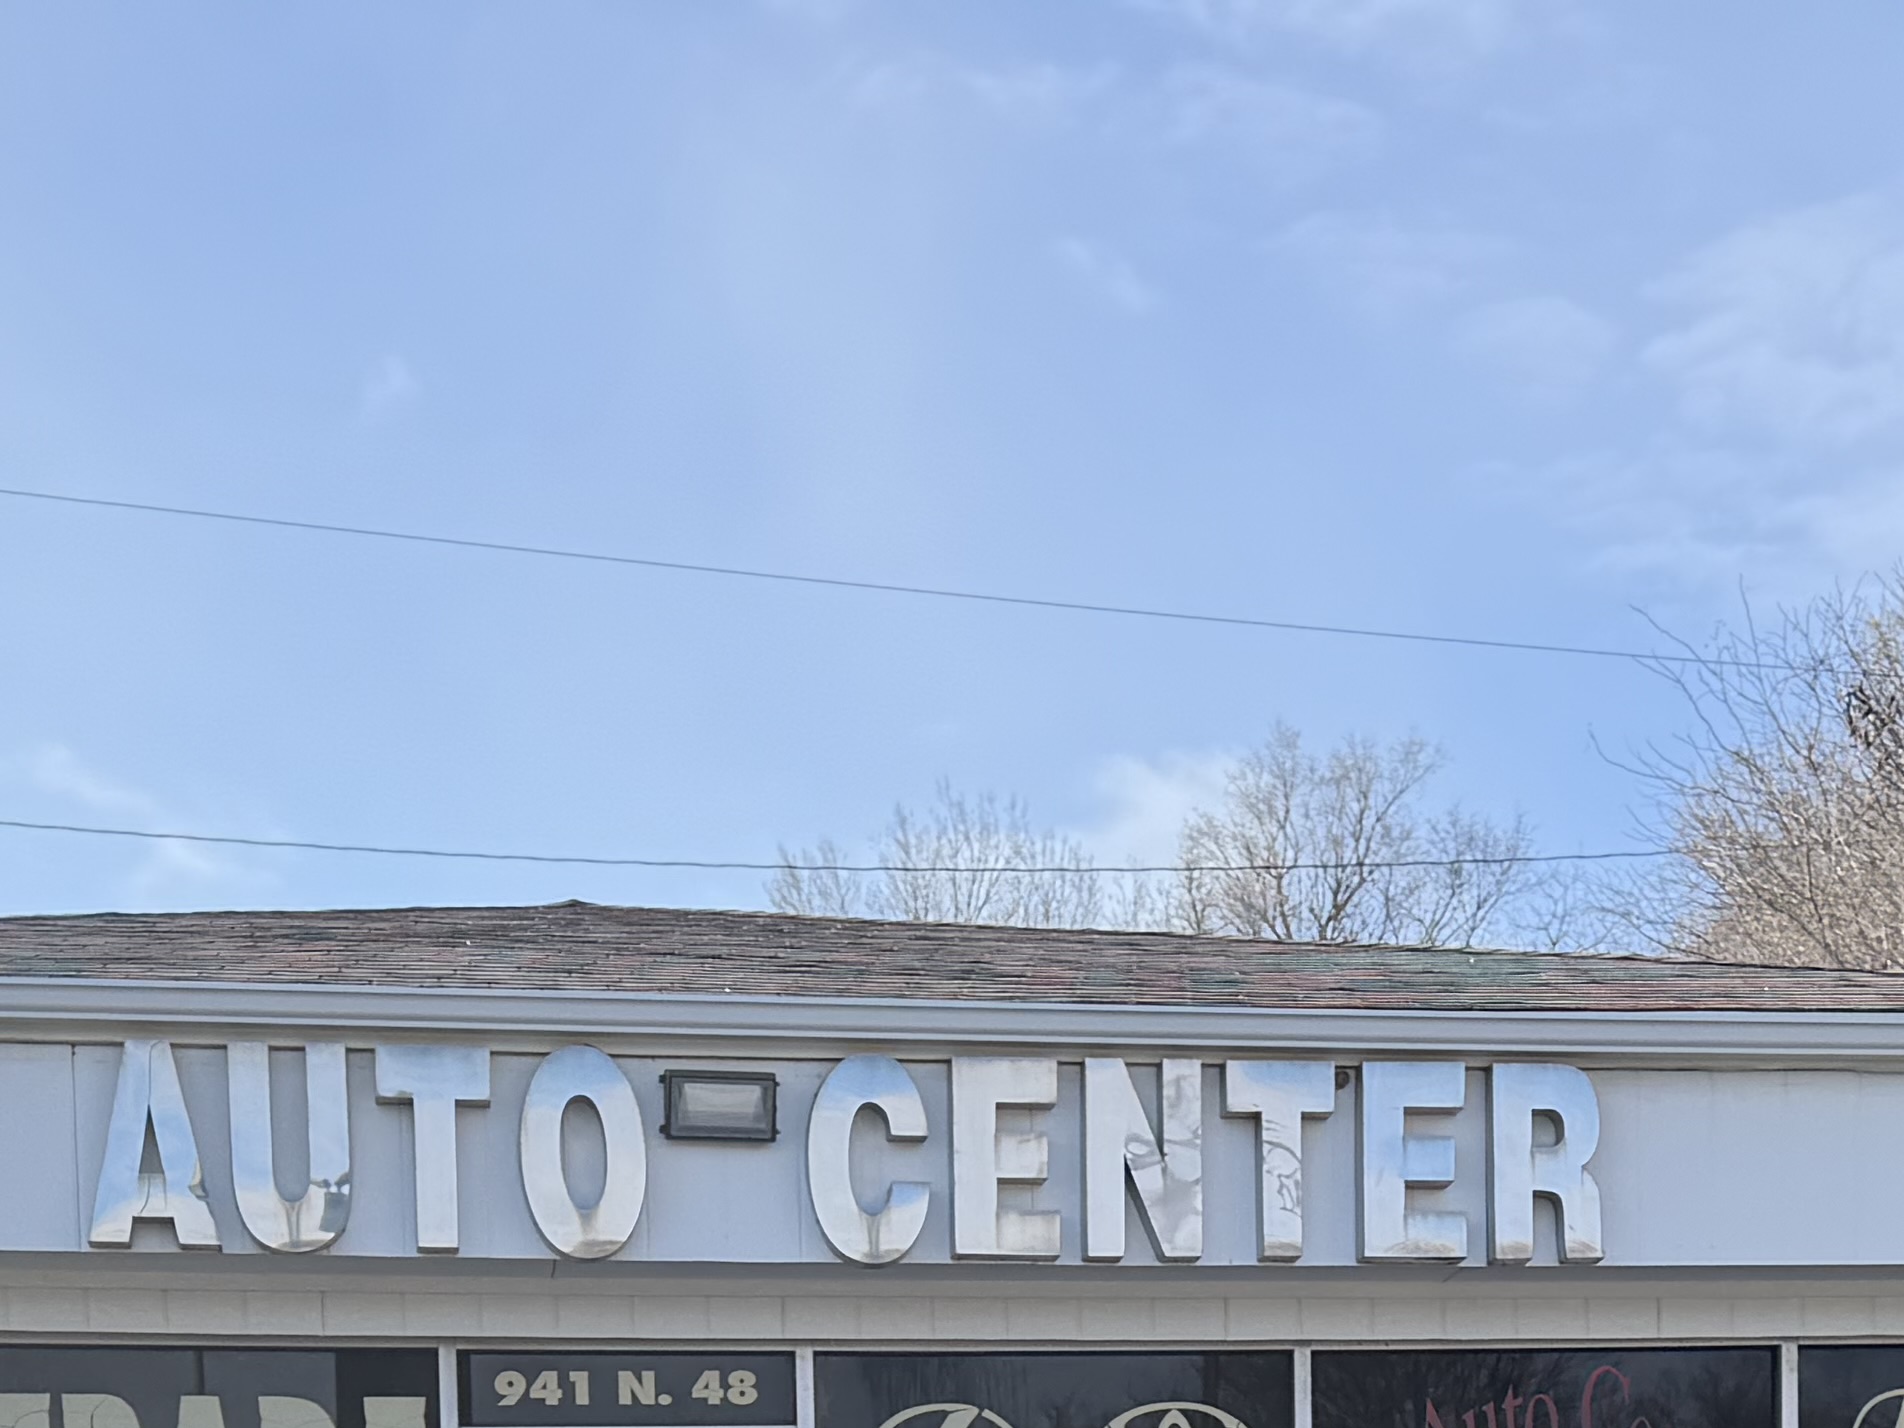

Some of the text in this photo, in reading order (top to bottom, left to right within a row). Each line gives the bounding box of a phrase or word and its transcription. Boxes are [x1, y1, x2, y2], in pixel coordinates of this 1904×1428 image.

[88, 1038, 648, 1261] AUTO
[807, 1053, 1604, 1267] CENTER
[493, 1369, 759, 1406] 941 N. 48
